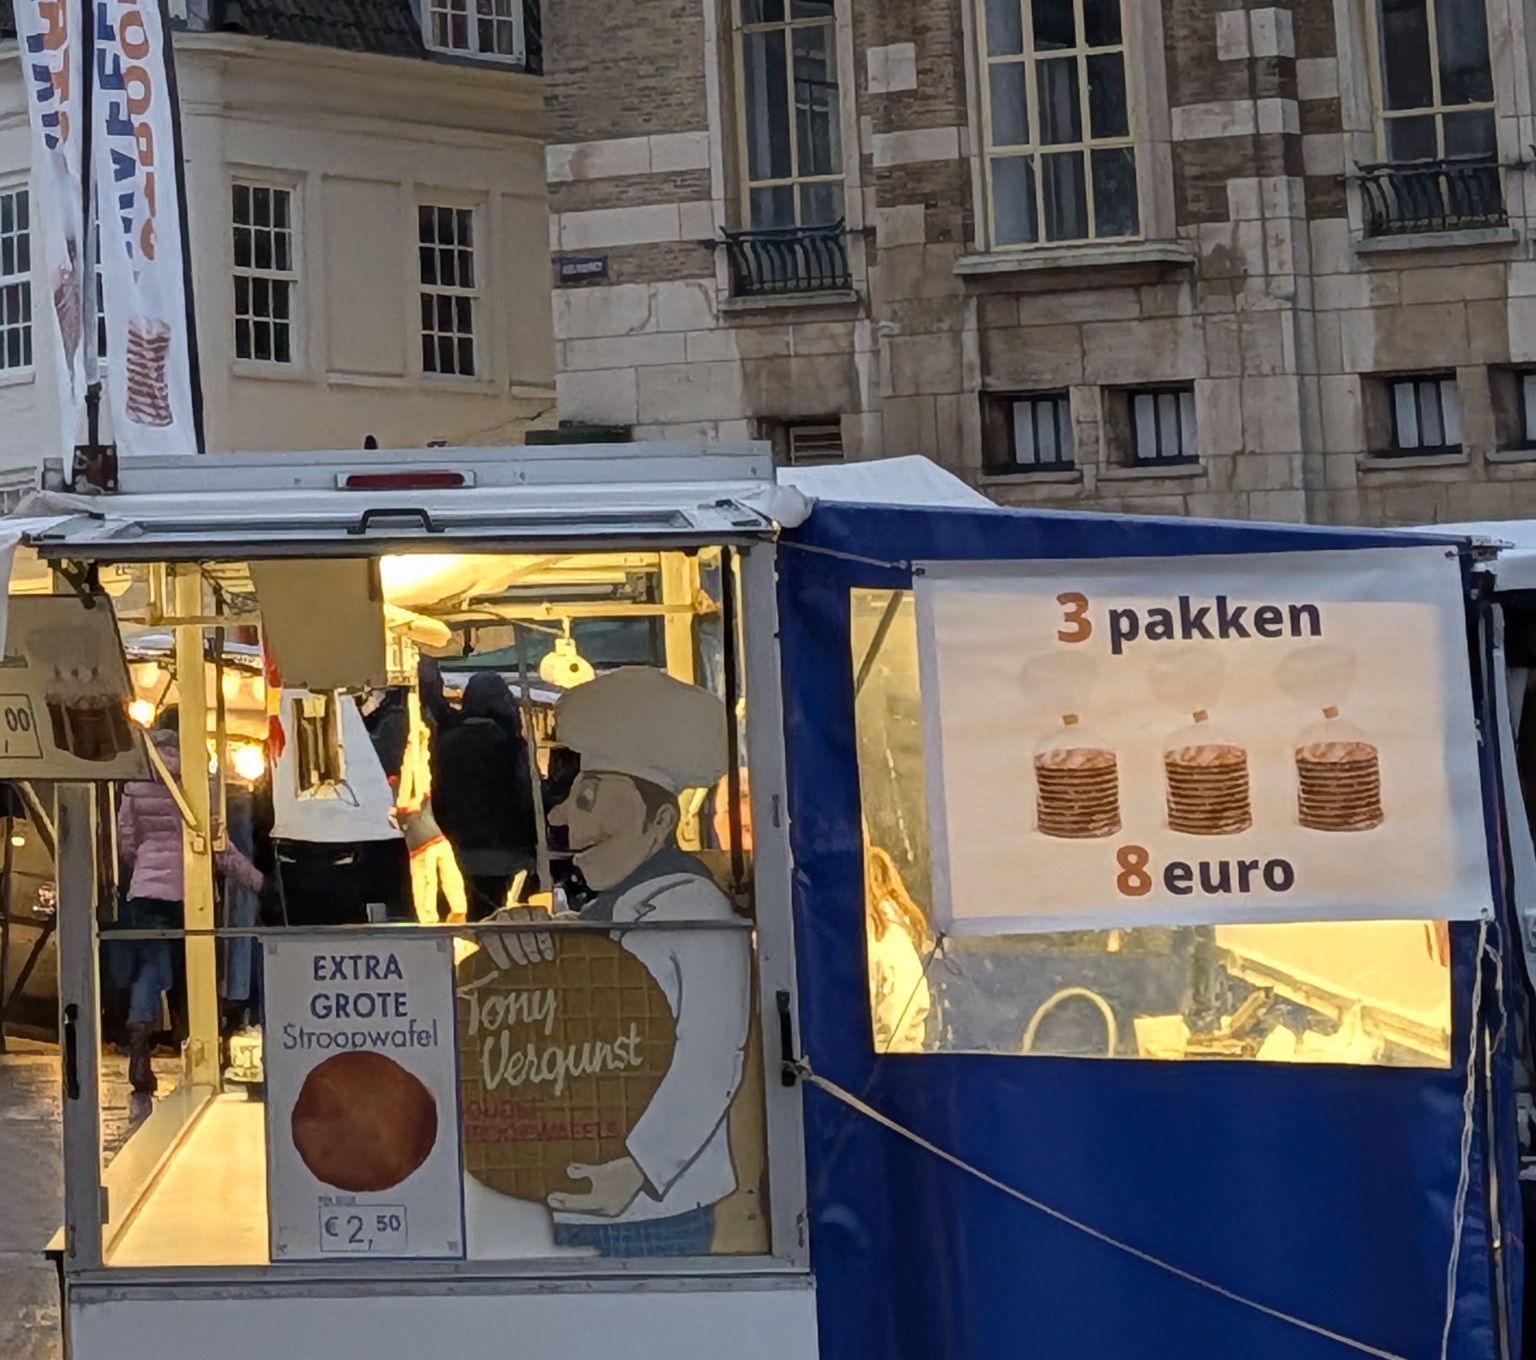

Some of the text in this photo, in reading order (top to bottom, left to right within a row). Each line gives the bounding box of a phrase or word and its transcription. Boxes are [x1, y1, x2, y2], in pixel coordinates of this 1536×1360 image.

[1056, 592, 1322, 655] 3 pakken
[1116, 845, 1295, 896] 8 euro
[313, 953, 403, 981] EXTRA
[310, 992, 408, 1020] GROTE
[456, 970, 557, 1036] Tony
[282, 1019, 439, 1050] Stroopwafel
[481, 1021, 643, 1096] Vergunst
